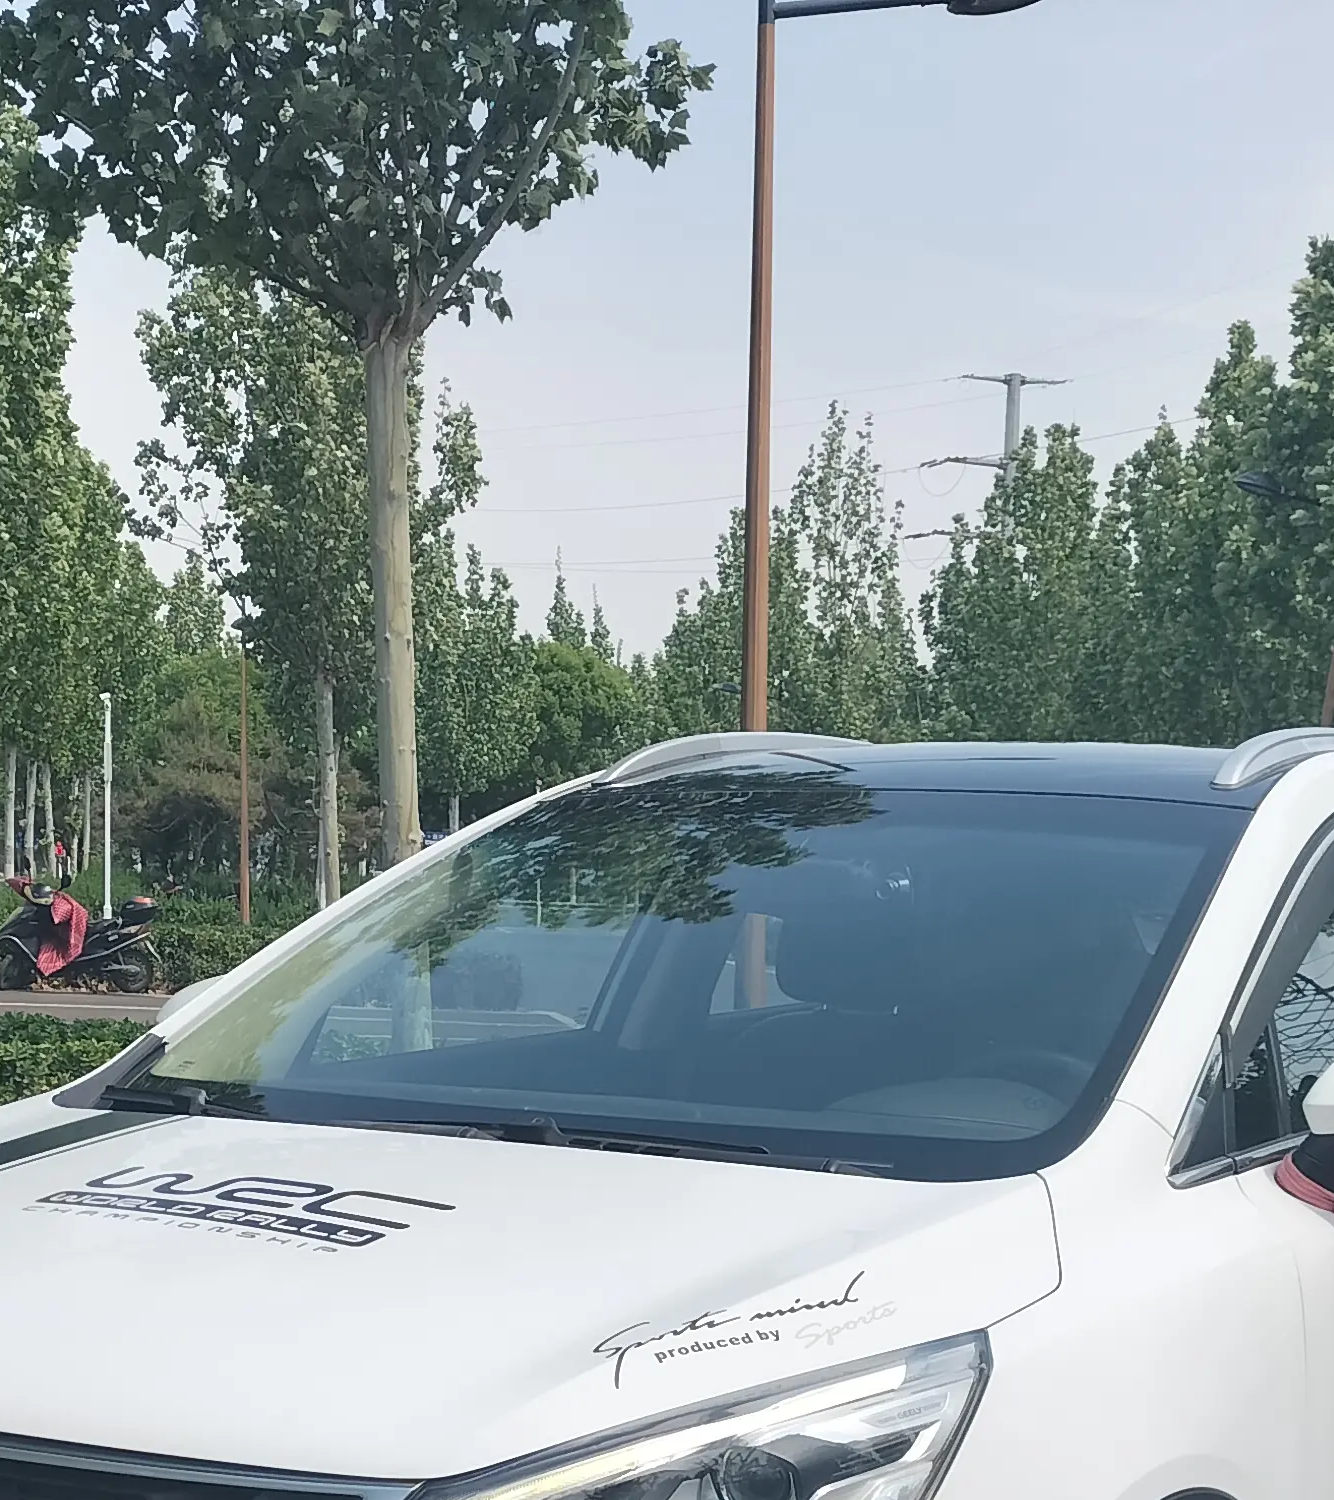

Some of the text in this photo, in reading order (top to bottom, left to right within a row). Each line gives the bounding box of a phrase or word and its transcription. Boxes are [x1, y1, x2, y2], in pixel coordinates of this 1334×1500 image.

[48, 1192, 372, 1242] WORLD RALLY
[86, 1166, 456, 1230] WRC
[22, 1205, 338, 1253] CHAMPIONSHIP
[654, 1301, 898, 1364] produced by Sports
[896, 1406, 923, 1420] GEELY
